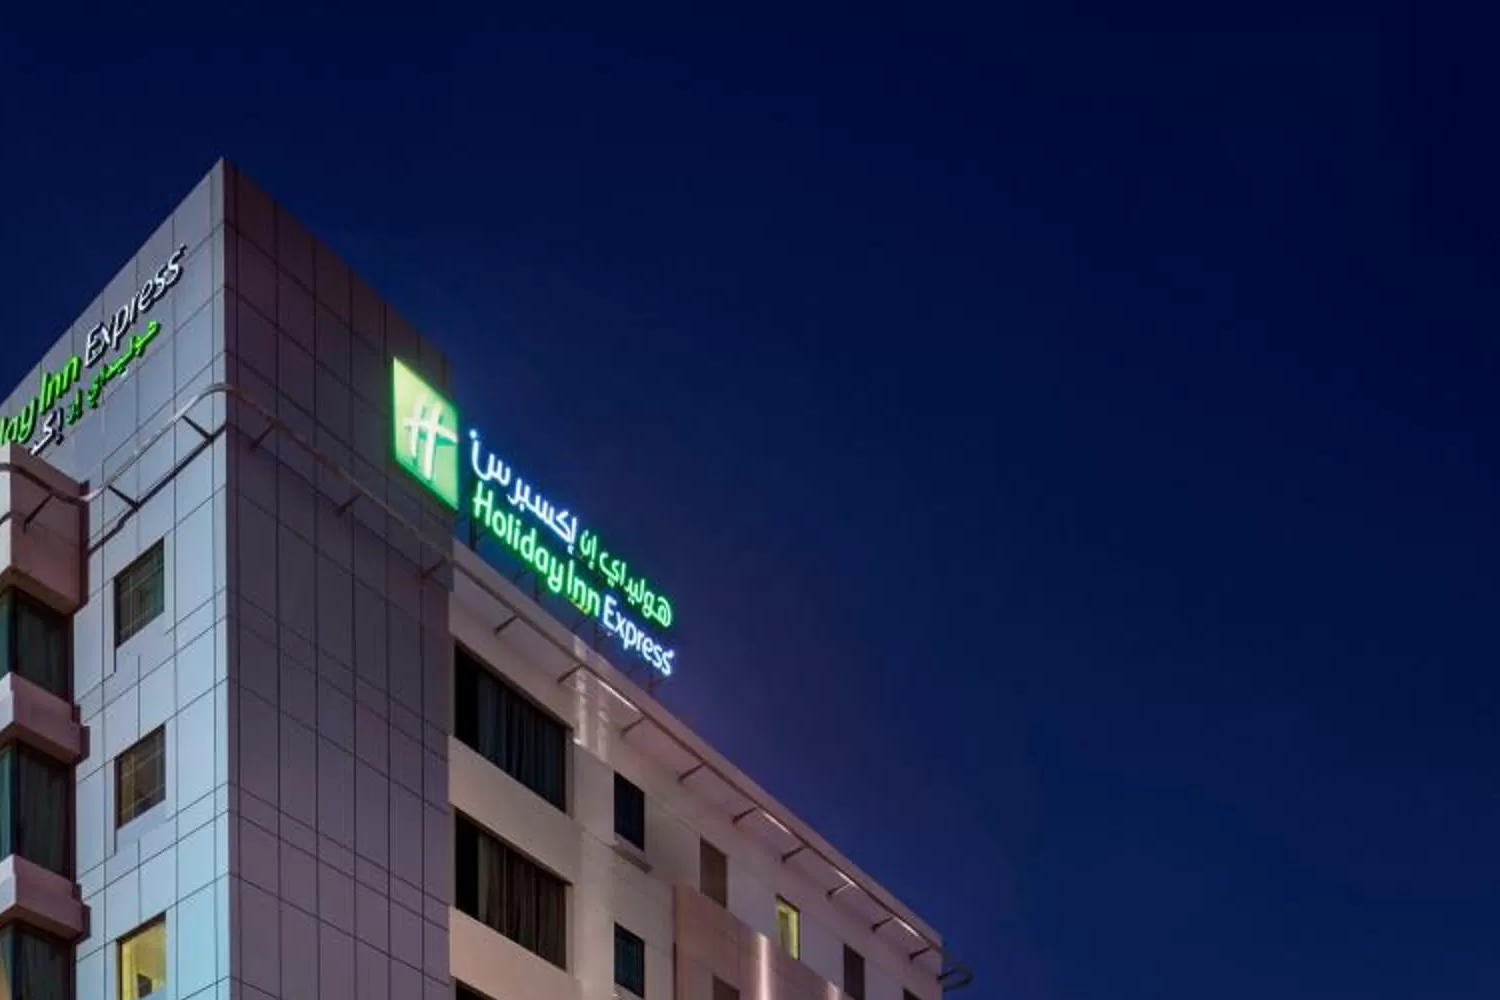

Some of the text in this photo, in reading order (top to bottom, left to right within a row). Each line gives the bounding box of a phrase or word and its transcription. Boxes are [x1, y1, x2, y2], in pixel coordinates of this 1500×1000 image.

[38, 354, 82, 415] Inn
[84, 250, 184, 368] Express
[472, 479, 673, 677] Holiday Inn Express
[599, 550, 673, 628] هوليداي
